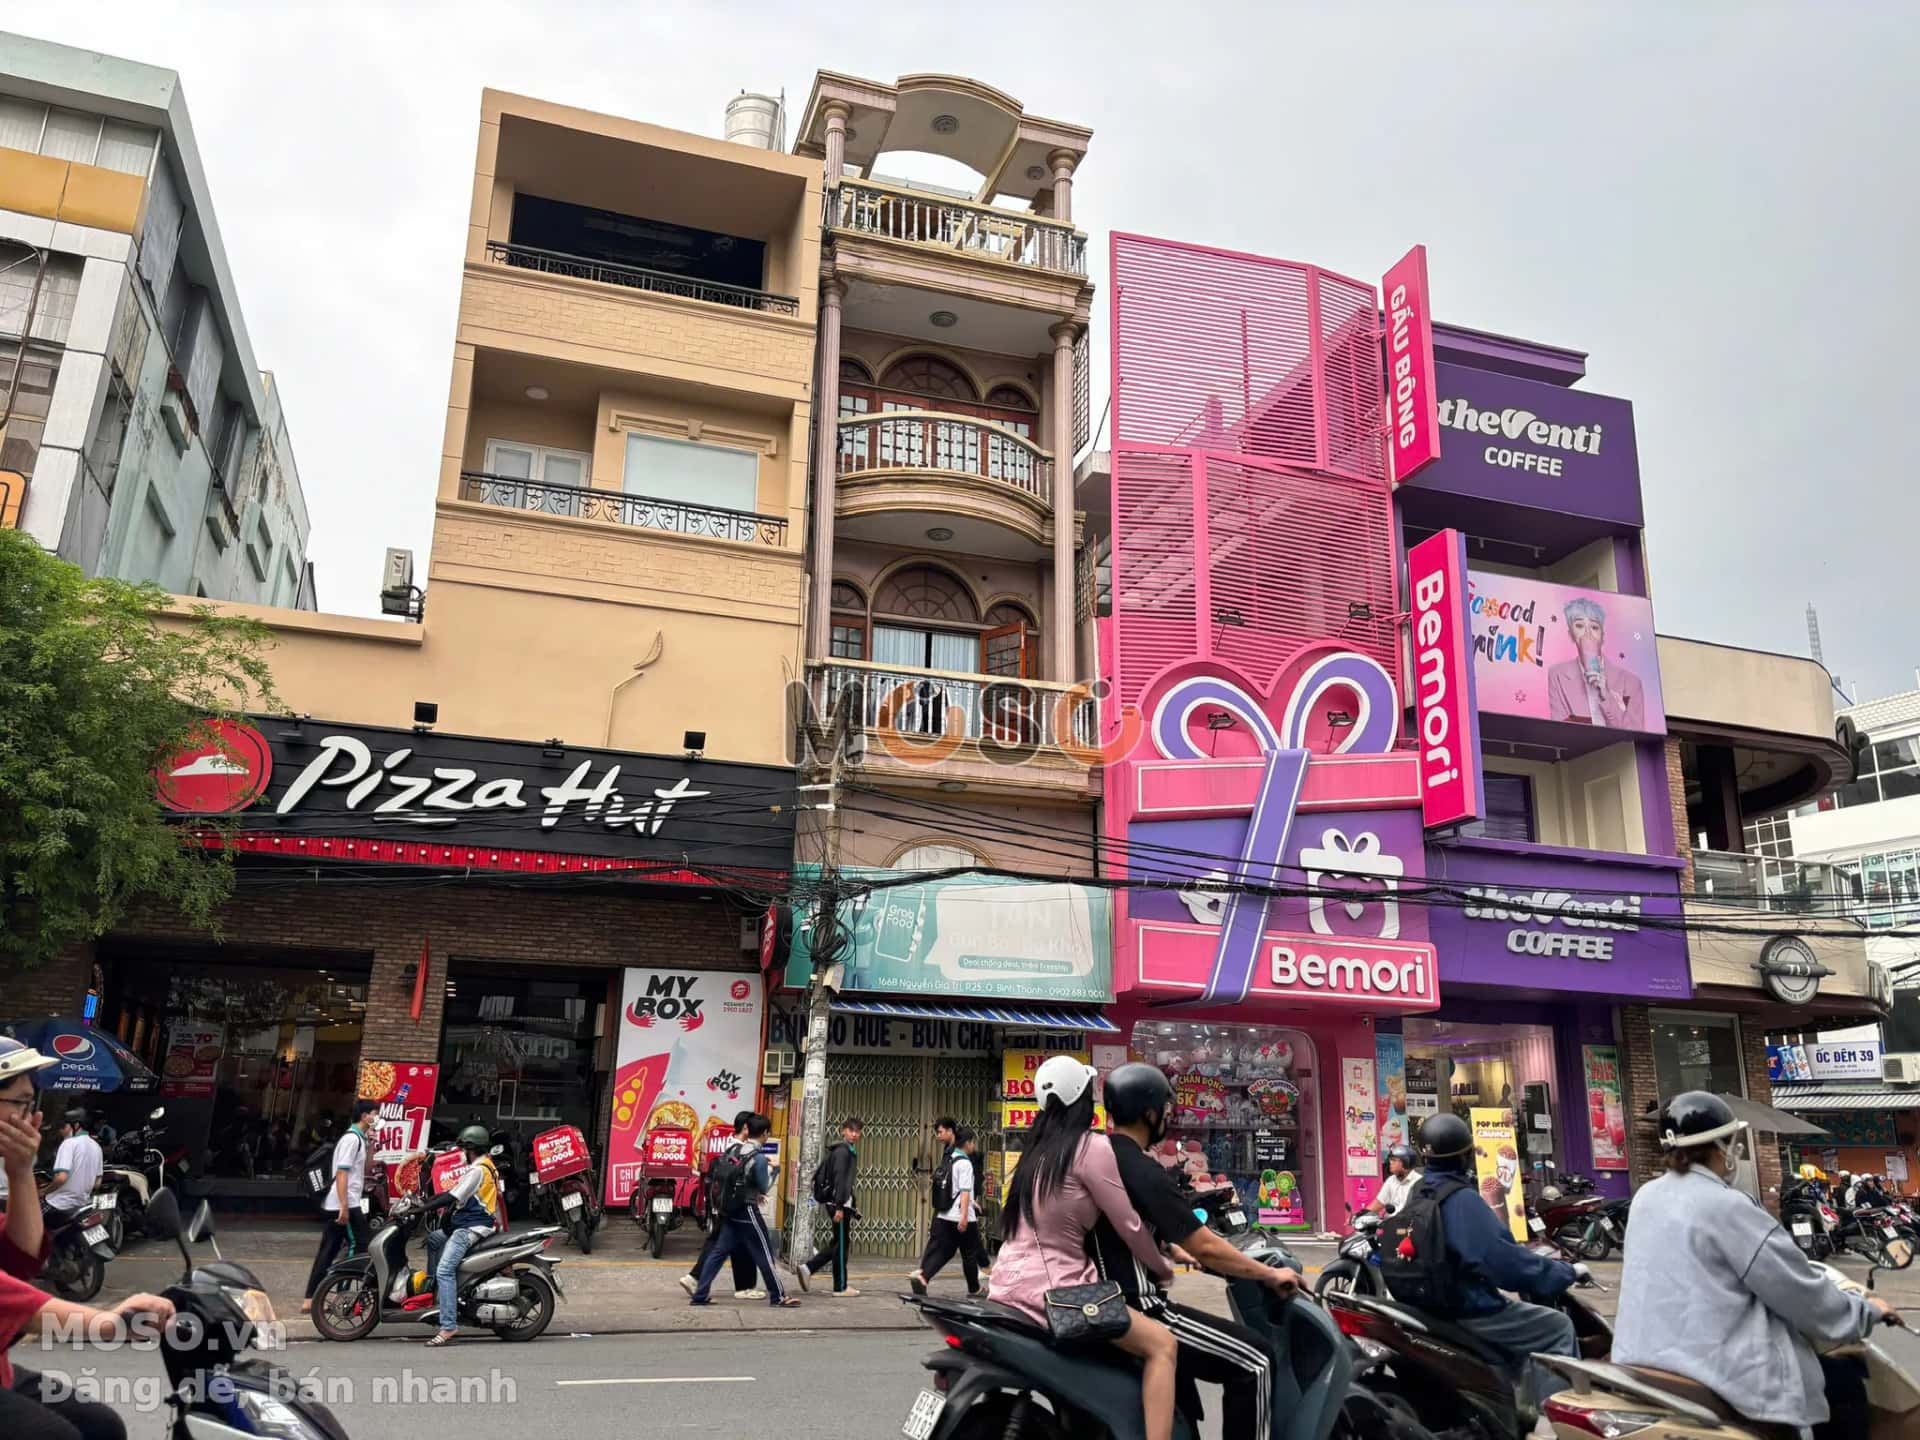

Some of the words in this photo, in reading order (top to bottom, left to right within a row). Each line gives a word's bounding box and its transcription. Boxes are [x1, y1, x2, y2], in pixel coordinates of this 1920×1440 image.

[1391, 284, 1414, 353] GẤU
[1394, 356, 1417, 449] BÔNG
[1484, 446, 1563, 477] COFFEE
[1416, 569, 1458, 788] Bemori
[276, 735, 528, 823] Pizza
[540, 759, 711, 836] Hut
[887, 912, 914, 929] Food
[889, 904, 913, 919] Grab
[1506, 928, 1614, 961] COFFEE
[1271, 945, 1426, 995] Bemori
[646, 974, 698, 998] MY
[634, 996, 705, 1020] BOX
[61, 1062, 97, 1072] pepsi
[1815, 1047, 1831, 1064] ỐC
[1834, 1047, 1857, 1063] ĐÊM
[1860, 1049, 1874, 1062] 39
[710, 1076, 741, 1095] BOX
[718, 1068, 742, 1084] MY
[1007, 1075, 1035, 1097] BÒ
[380, 1102, 404, 1120] MUA
[405, 1106, 428, 1152] 1
